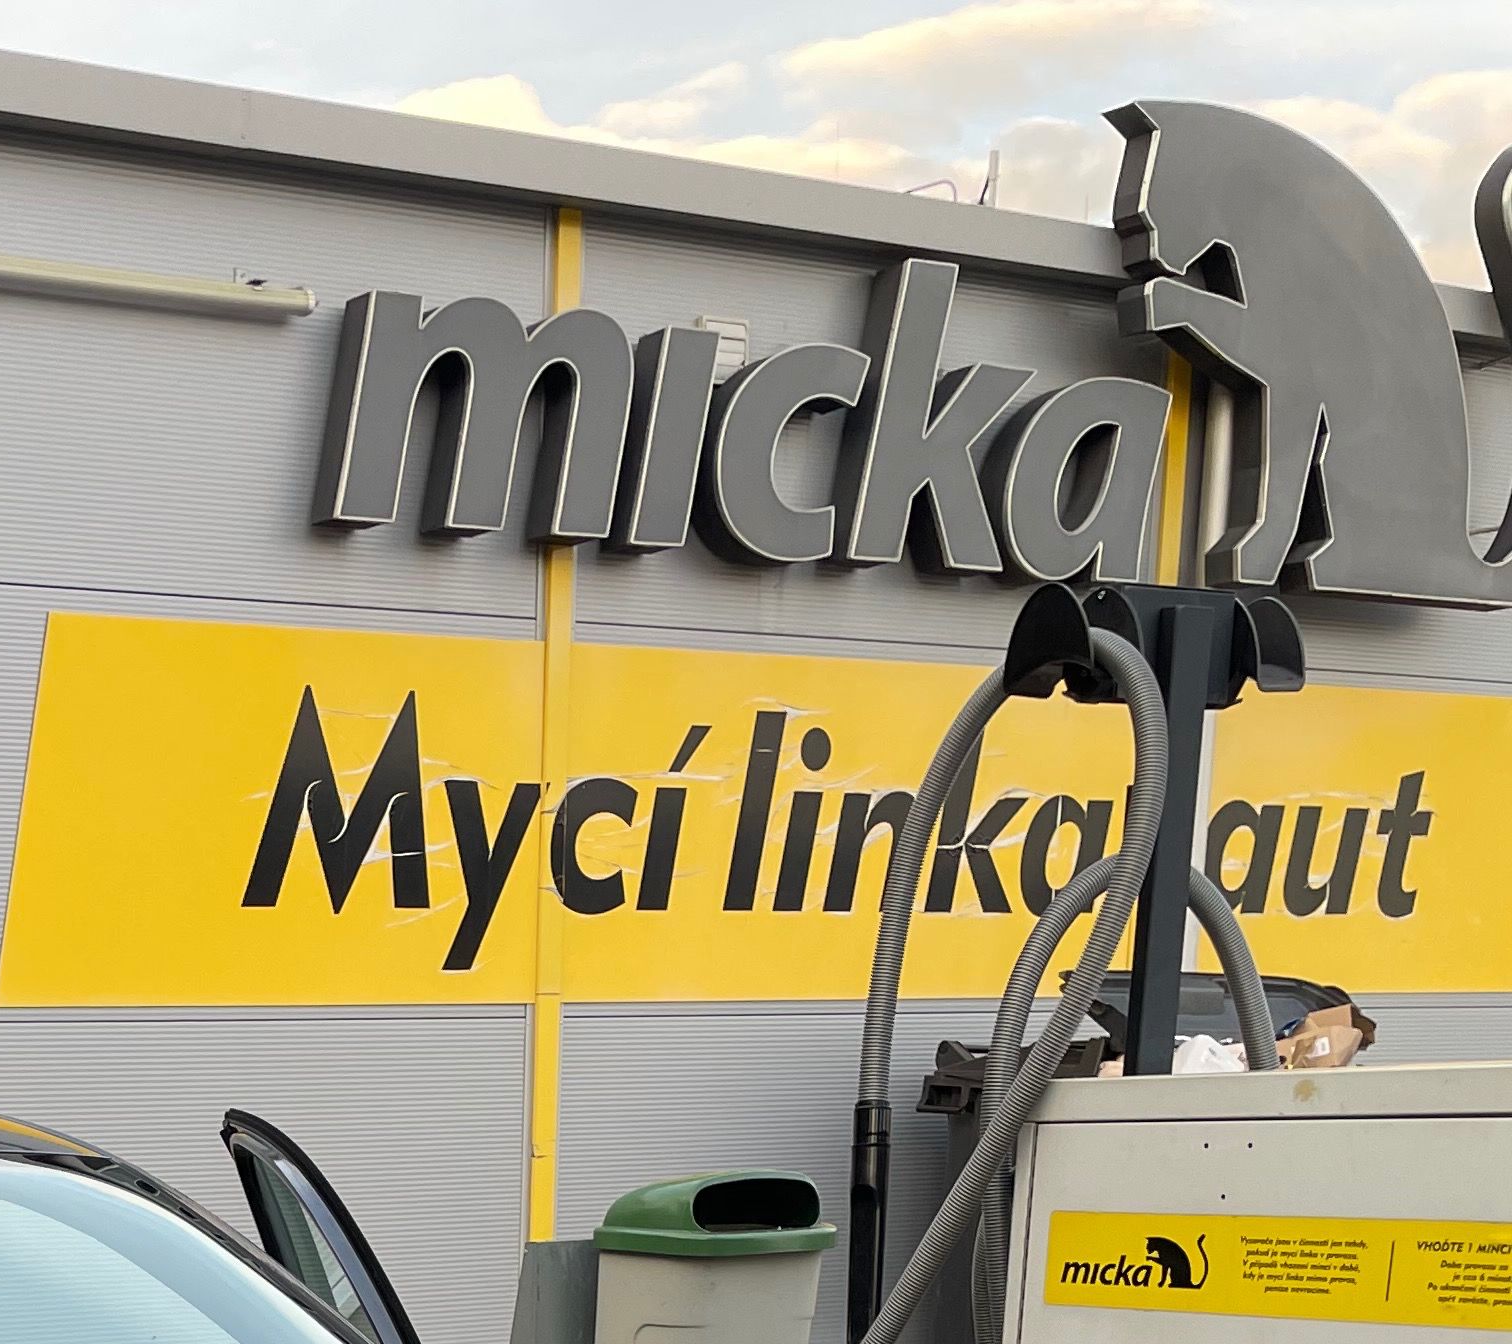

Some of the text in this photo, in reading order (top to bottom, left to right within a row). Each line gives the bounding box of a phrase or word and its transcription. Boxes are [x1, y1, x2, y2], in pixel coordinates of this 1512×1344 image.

[314, 258, 1173, 582] micka
[241, 685, 1434, 971] Mycí linka aut
[1061, 1254, 1153, 1288] micka
